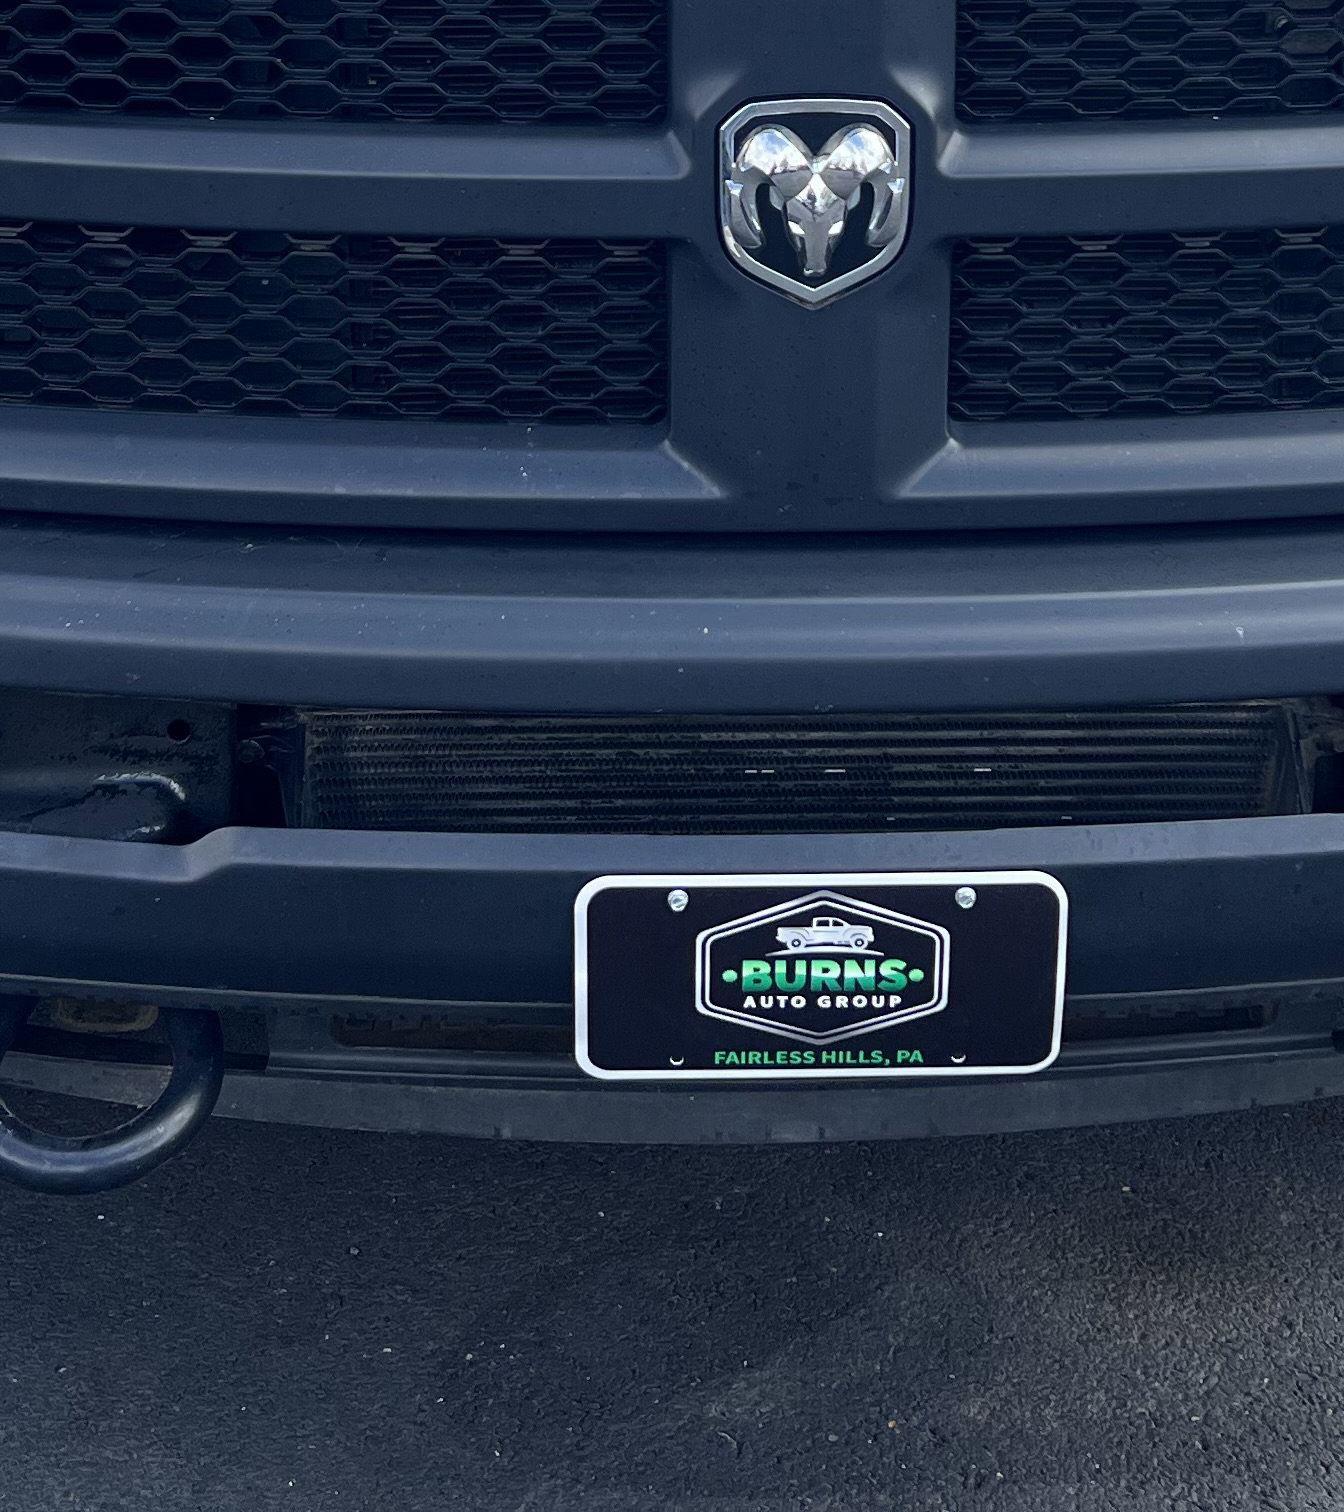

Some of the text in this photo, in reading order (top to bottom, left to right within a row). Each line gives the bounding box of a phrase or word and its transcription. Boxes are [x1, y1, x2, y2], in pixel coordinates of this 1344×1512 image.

[741, 959, 908, 992] BURNS
[743, 995, 903, 1009] AUTO GROUP
[714, 1049, 924, 1066] FAIRLESS HILLS, PA
